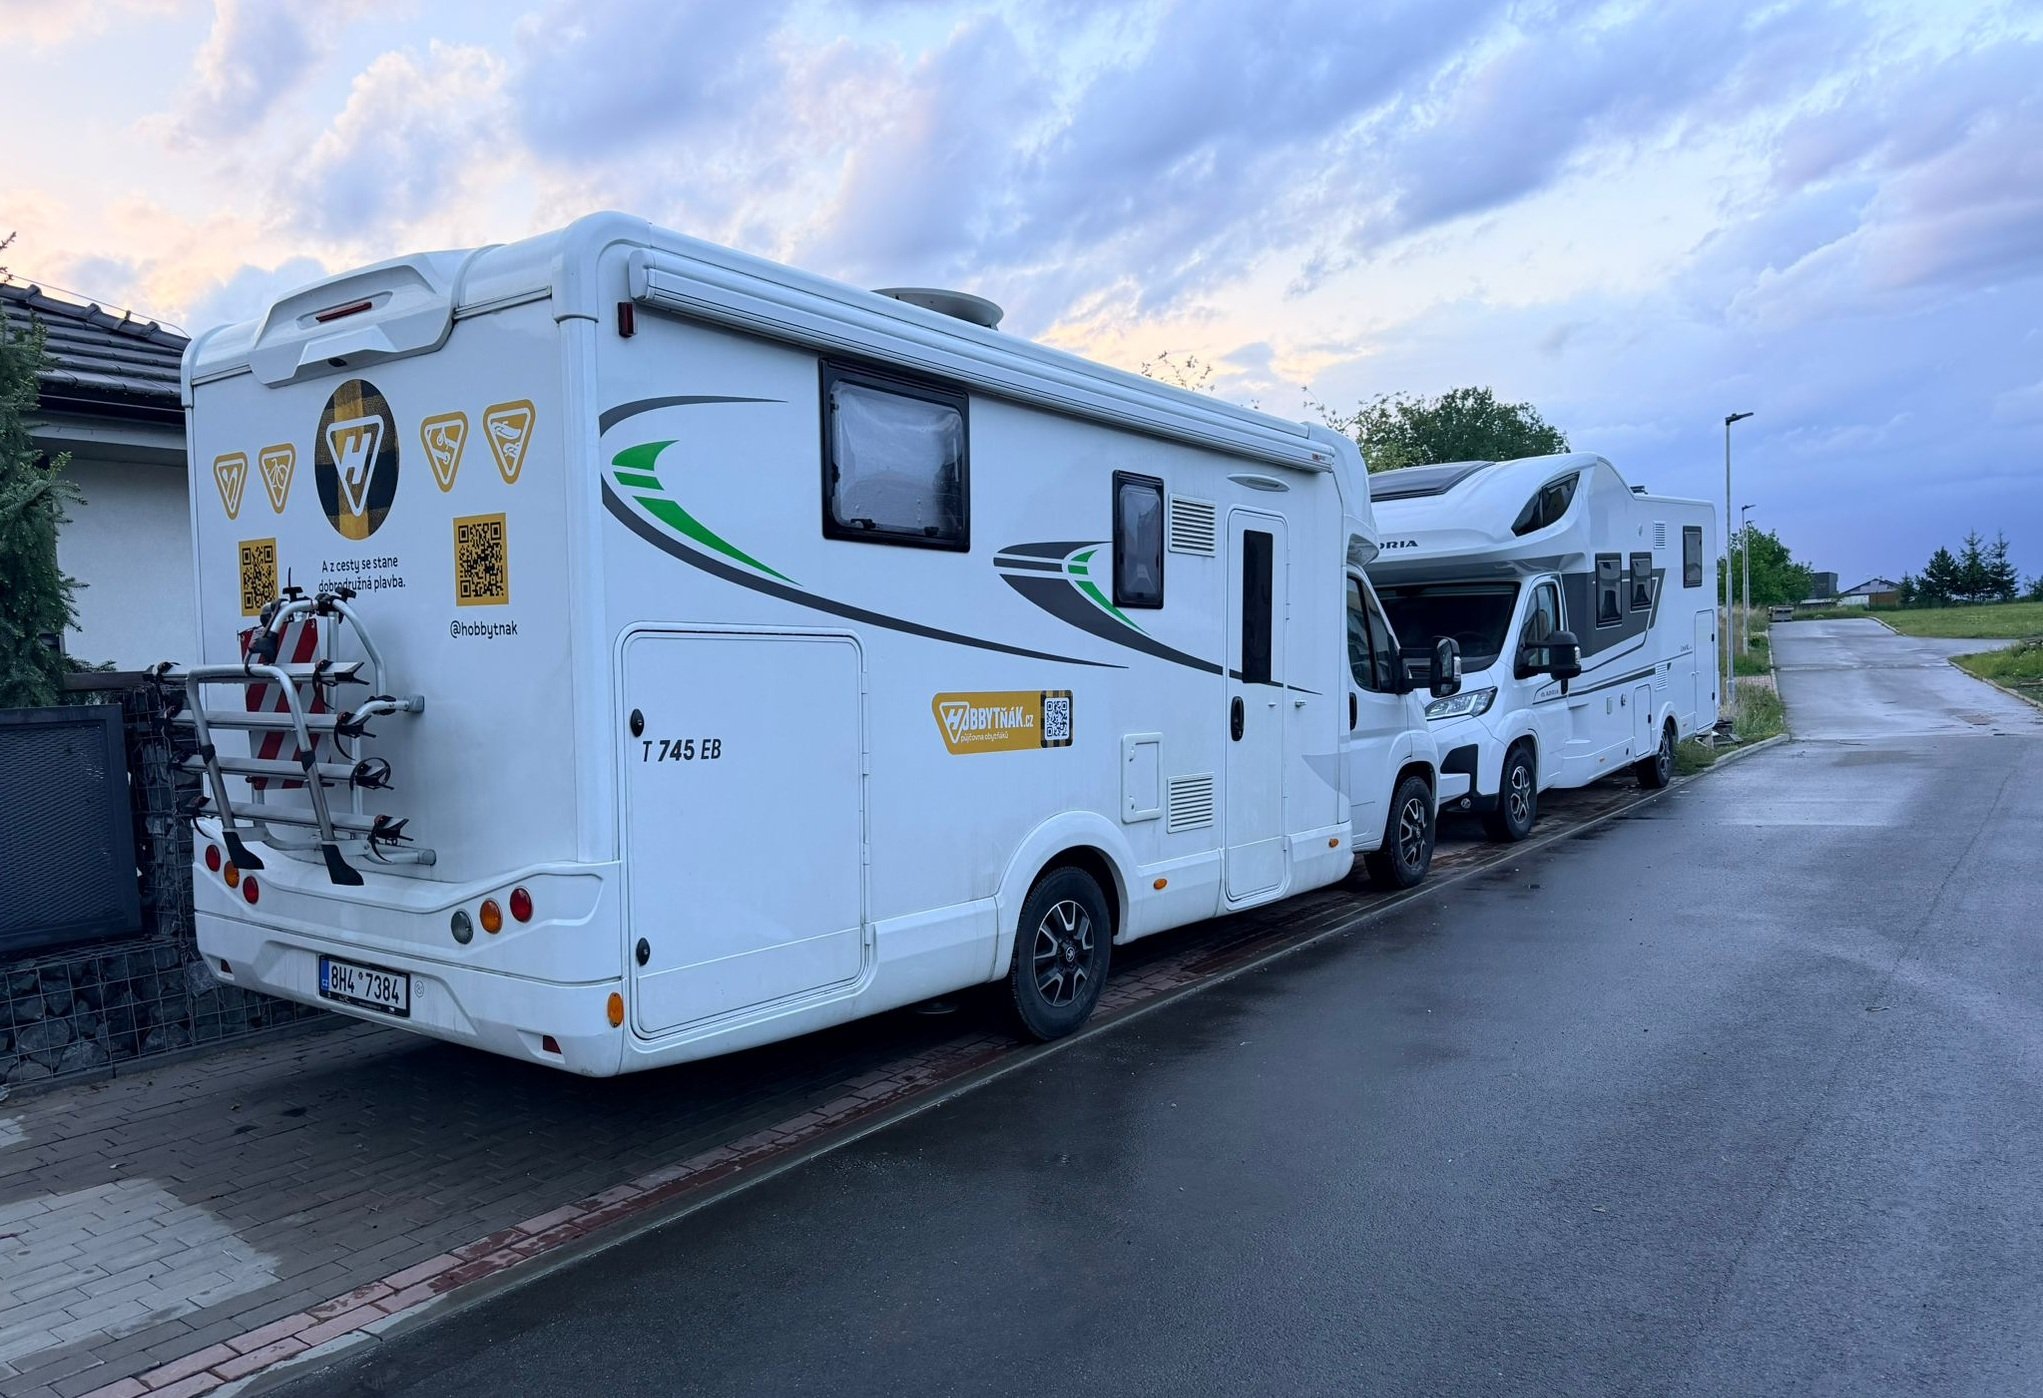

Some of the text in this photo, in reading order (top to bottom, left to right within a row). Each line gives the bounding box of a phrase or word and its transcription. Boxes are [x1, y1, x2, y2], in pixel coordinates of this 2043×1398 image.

[340, 432, 372, 485] H
[321, 556, 398, 574] A z cesty se stane
[318, 574, 406, 593] dobrodružná plavba.
[450, 620, 518, 640] @hobbytnak
[642, 738, 722, 762] T 745 EB
[331, 965, 355, 994] 8H4
[365, 972, 400, 1004] 7384
